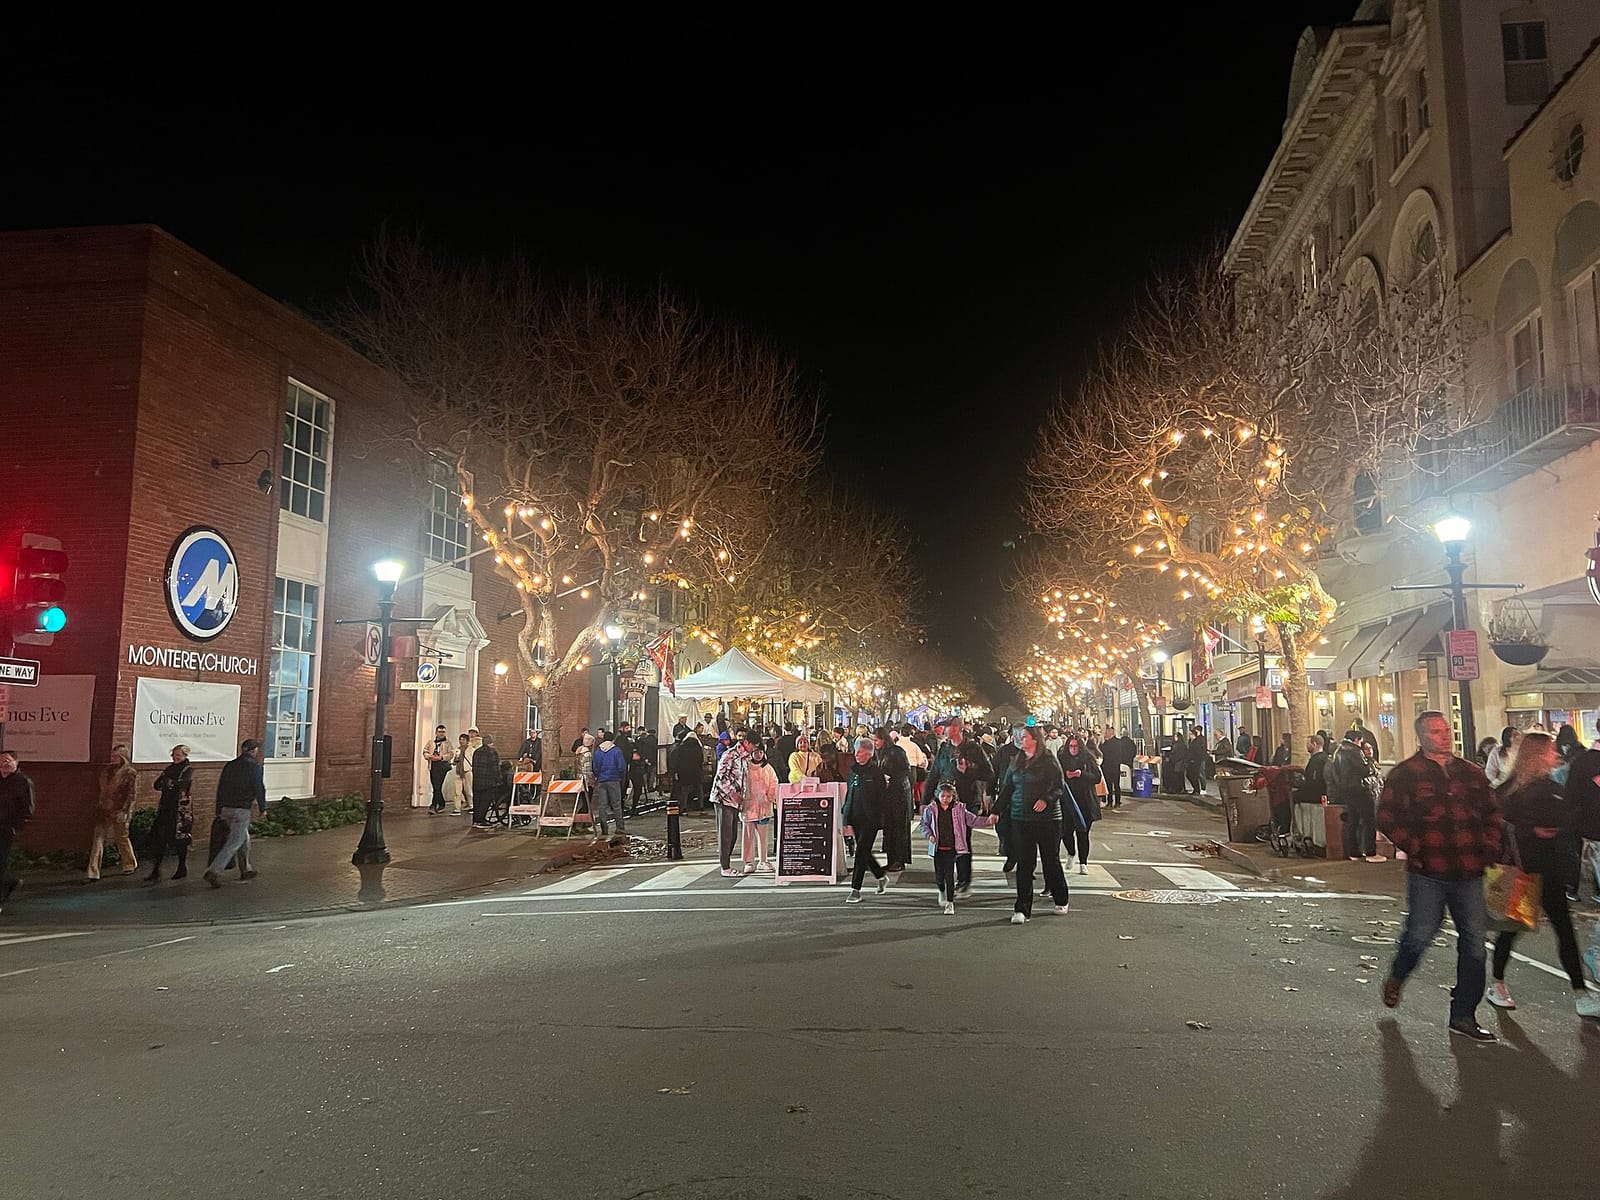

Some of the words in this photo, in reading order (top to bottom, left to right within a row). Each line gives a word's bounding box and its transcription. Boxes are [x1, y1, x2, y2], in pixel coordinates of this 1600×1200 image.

[0, 665, 11, 676] NE
[14, 666, 34, 678] WAY
[40, 706, 70, 722] Eve
[149, 709, 205, 726] Christmas
[205, 711, 225, 726] Eve
